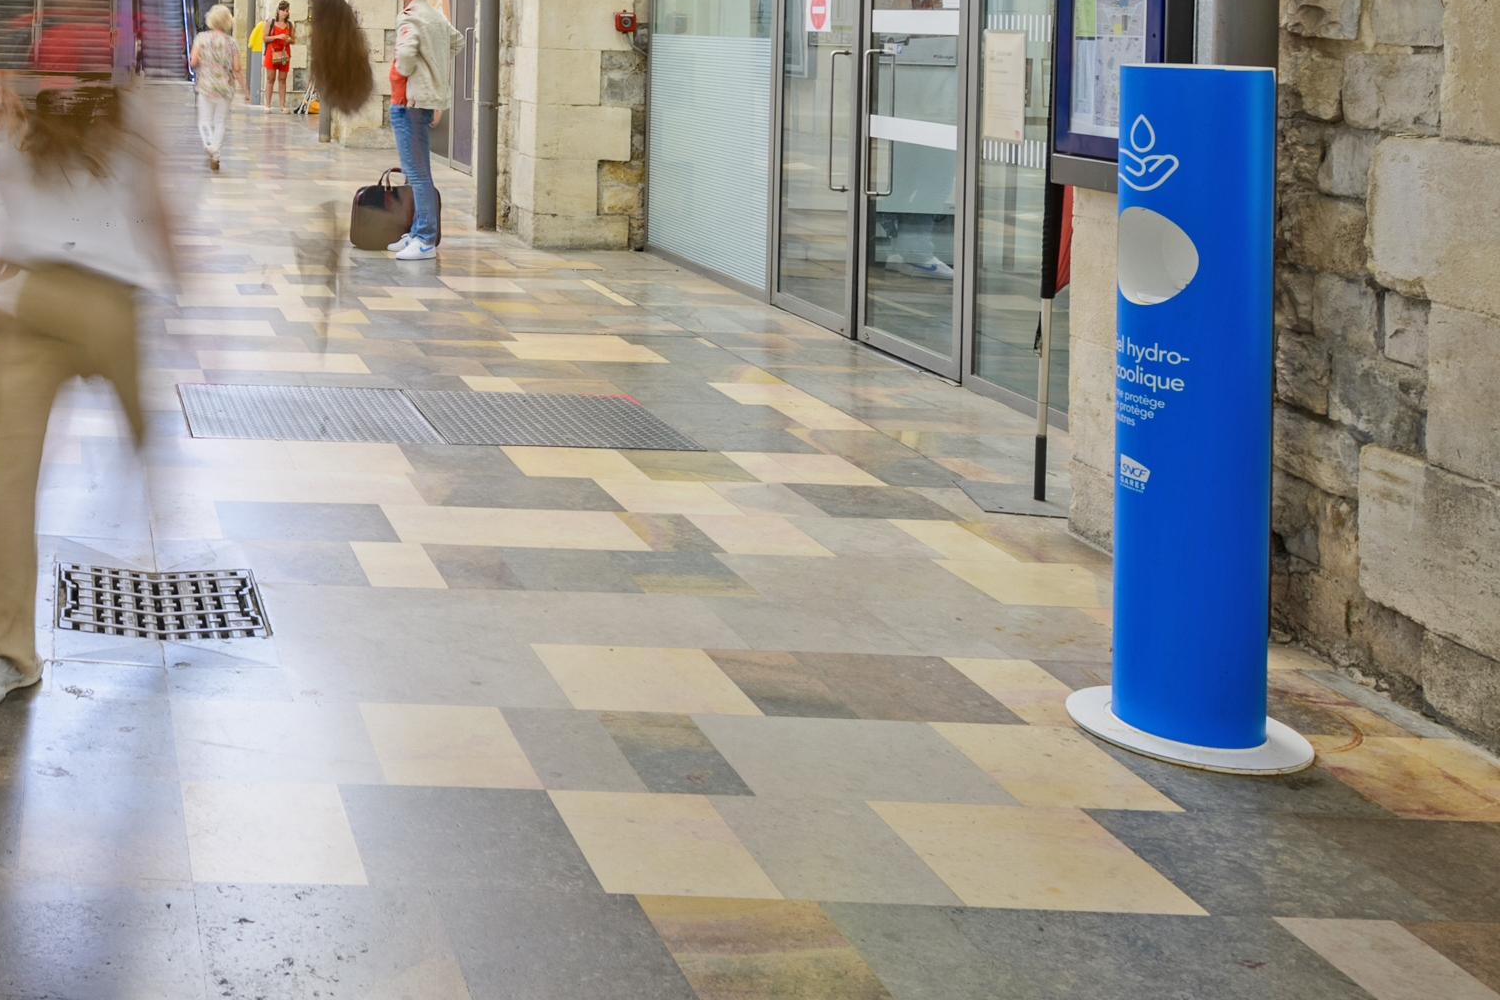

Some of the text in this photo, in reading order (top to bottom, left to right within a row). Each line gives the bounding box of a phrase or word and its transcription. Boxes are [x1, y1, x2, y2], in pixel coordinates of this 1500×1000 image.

[1127, 336, 1190, 365] hydro-
[1116, 364, 1185, 393] coolique
[1119, 401, 1155, 421] protège
[1124, 392, 1166, 411] protège
[1121, 463, 1148, 478] SNCF
[1120, 476, 1146, 491] GARES
